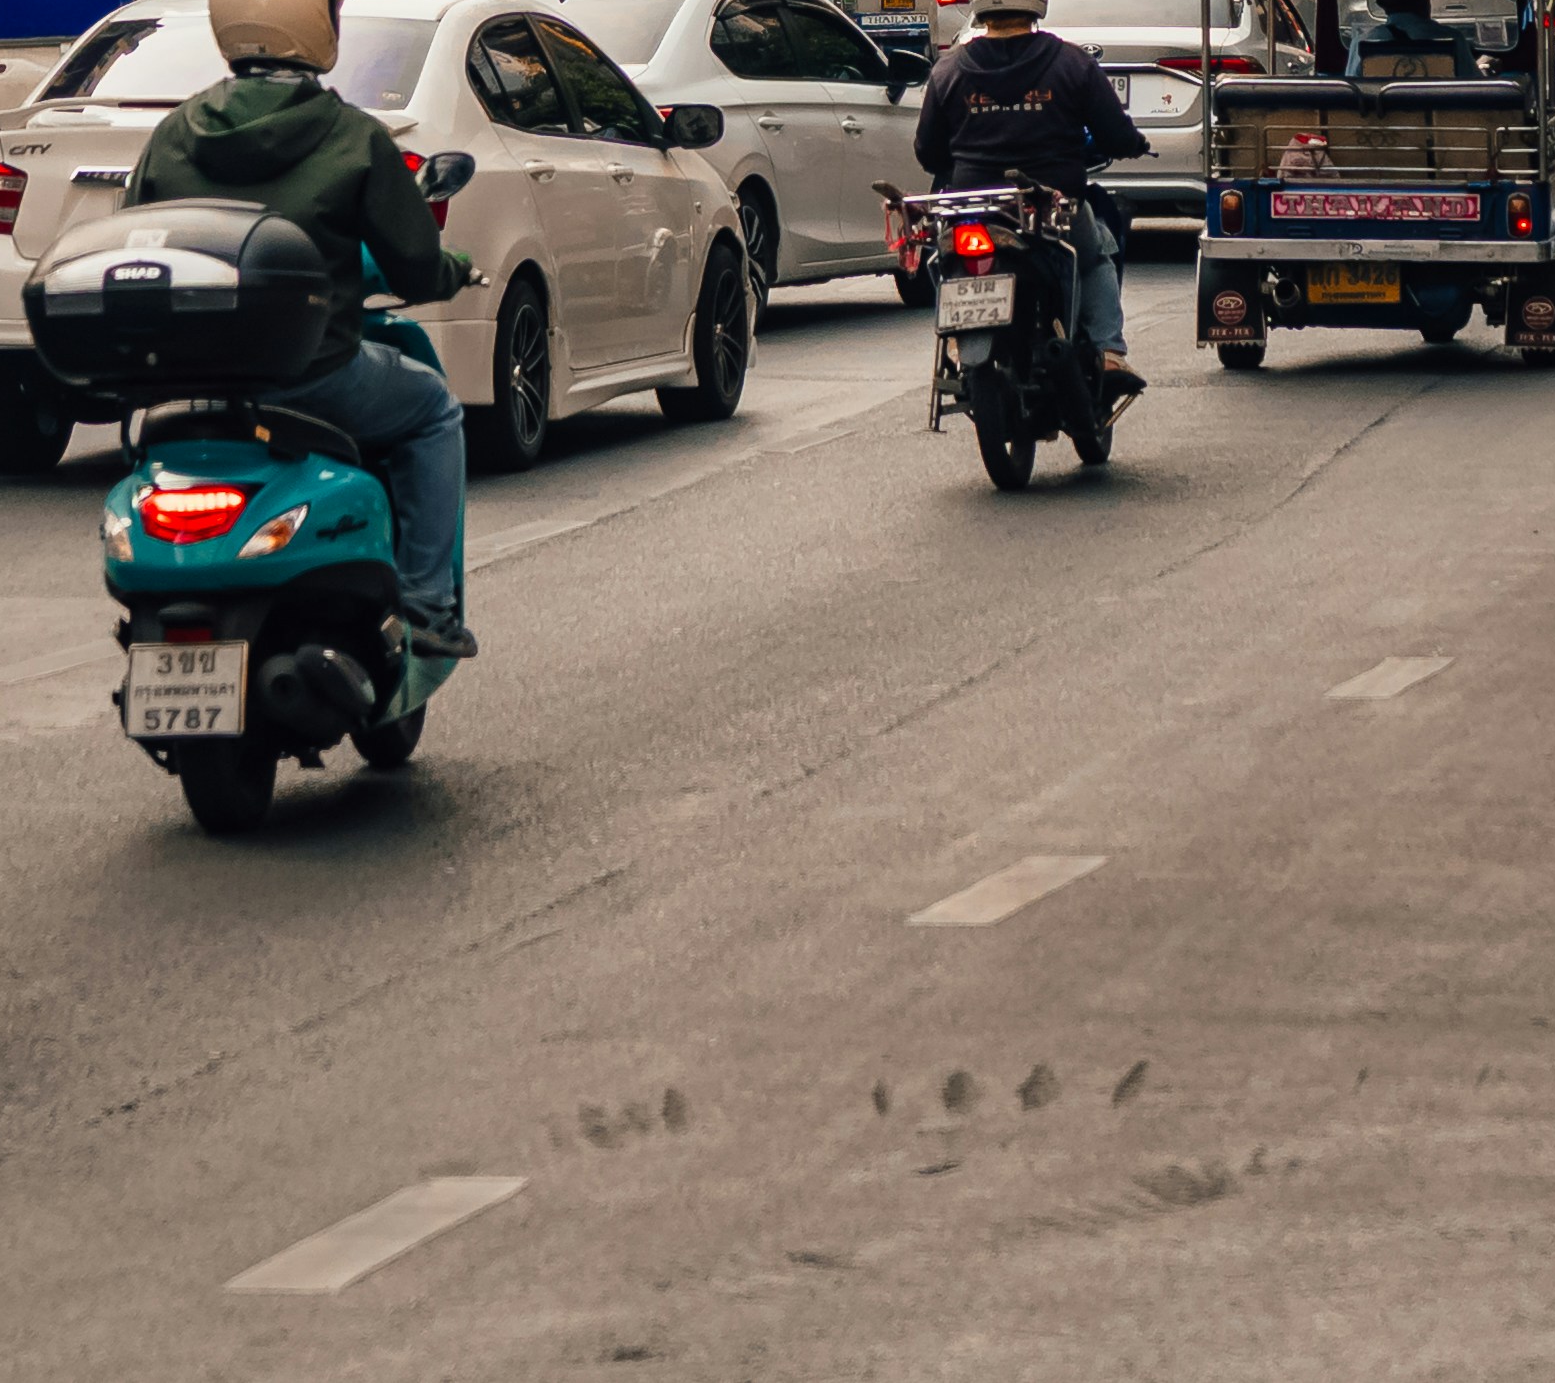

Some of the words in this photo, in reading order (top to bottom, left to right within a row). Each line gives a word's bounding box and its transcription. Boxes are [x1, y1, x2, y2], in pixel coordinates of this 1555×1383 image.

[866, 13, 928, 26] THAILAND
[9, 142, 53, 157] CITY
[1280, 193, 1480, 219] THAILAND
[112, 265, 162, 282] SHAD
[950, 307, 1001, 323] 4274
[144, 708, 222, 732] 5787
